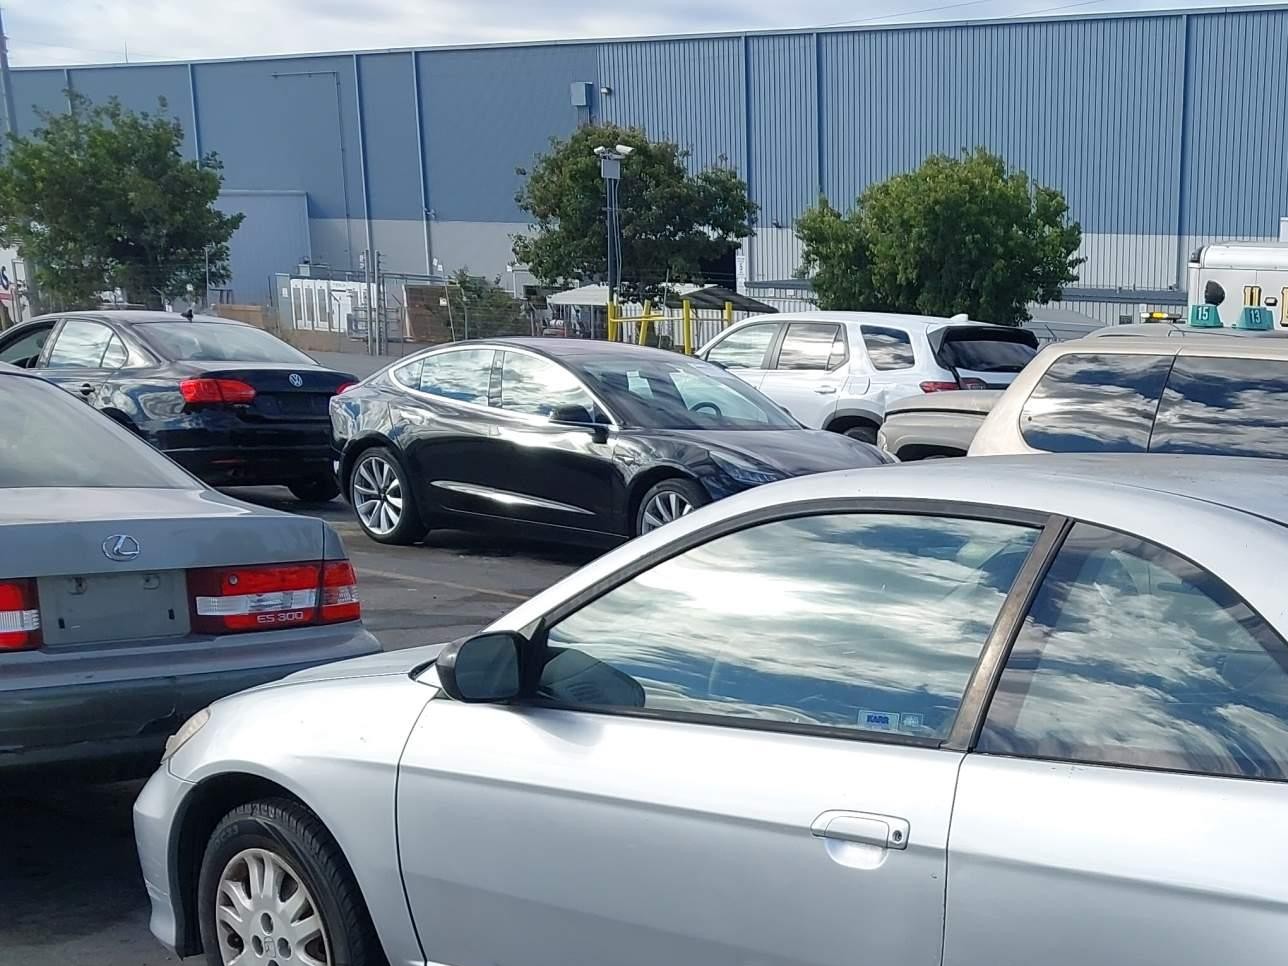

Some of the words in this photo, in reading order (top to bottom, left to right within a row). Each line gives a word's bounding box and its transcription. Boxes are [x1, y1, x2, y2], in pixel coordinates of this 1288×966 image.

[1197, 306, 1210, 321] 15
[1249, 309, 1262, 324] 13
[257, 614, 275, 623] ES
[277, 611, 304, 621] 300
